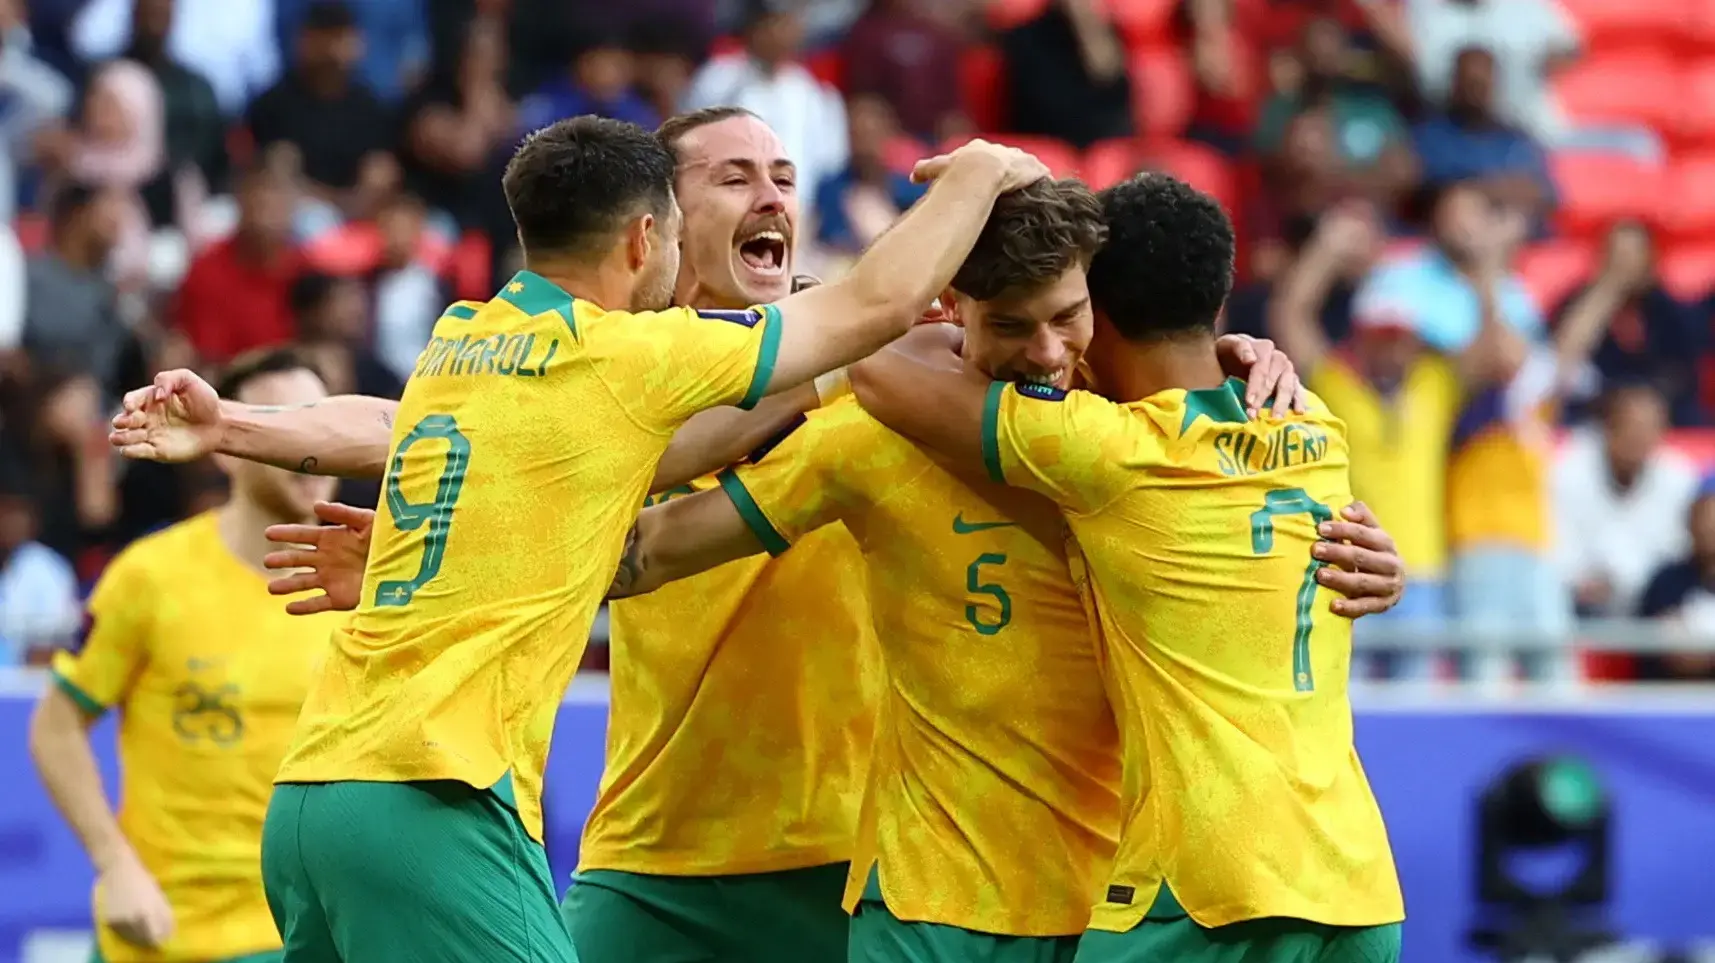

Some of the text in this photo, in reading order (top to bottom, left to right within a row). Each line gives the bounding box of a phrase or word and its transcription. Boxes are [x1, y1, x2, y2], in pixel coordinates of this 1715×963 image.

[1213, 424, 1328, 476] SILVERA
[375, 414, 471, 606] 9
[965, 552, 1011, 635] 5
[1250, 488, 1333, 692] 7
[172, 682, 244, 748] 25
